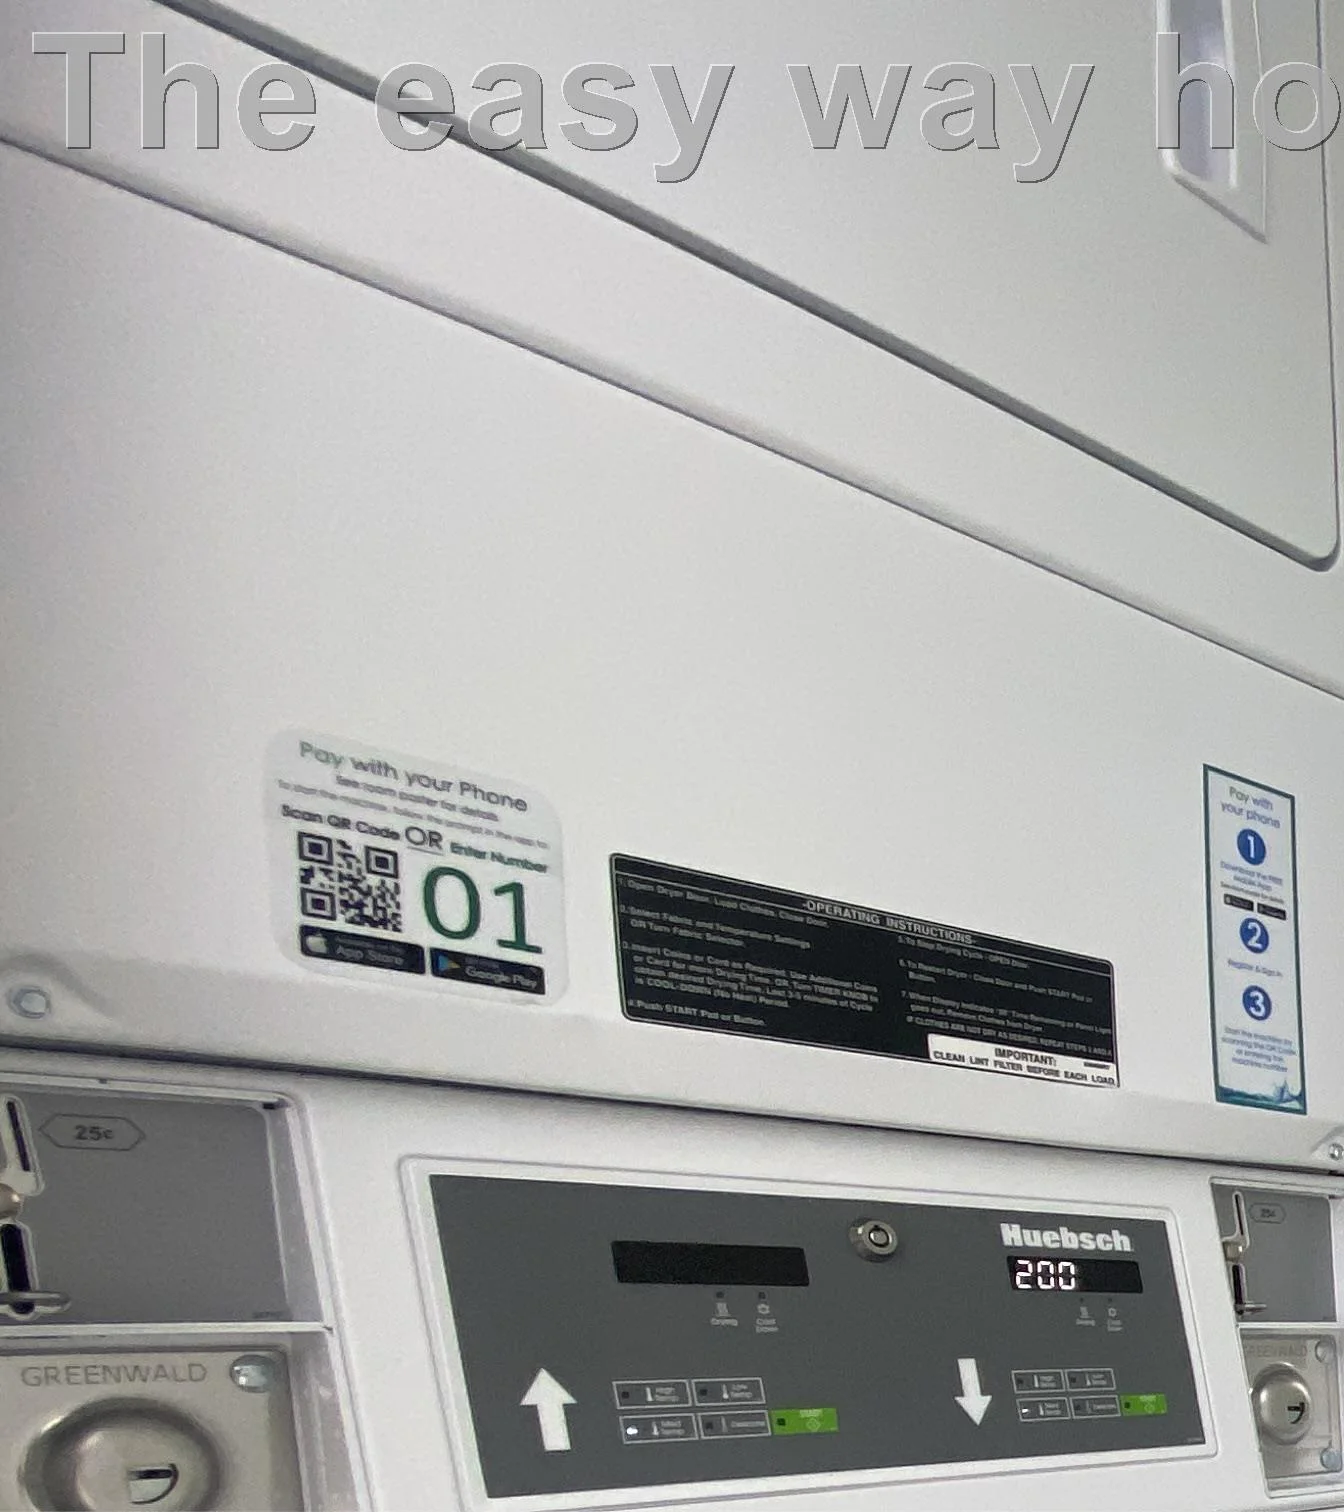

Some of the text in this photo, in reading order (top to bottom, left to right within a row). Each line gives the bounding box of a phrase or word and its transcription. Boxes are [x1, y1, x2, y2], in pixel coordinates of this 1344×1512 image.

[300, 740, 528, 812] Pay with your Phone
[1229, 786, 1273, 810] Pay with
[1220, 801, 1280, 829] your phone
[282, 804, 548, 873] Scan QR Code OR Enter Number
[422, 866, 543, 953] 01
[1247, 922, 1263, 949] 2
[335, 946, 404, 966] App Store
[465, 966, 537, 989] Google Play
[665, 1003, 697, 1016] START
[1250, 990, 1265, 1017] 3
[934, 1051, 965, 1063] CLEAN
[969, 1055, 989, 1066] LINT
[993, 1060, 1023, 1071] FILTER
[1026, 1065, 1060, 1078] BEFORE
[1064, 1070, 1088, 1081] EACH
[1000, 1223, 1132, 1252] Huebsch
[1015, 1260, 1076, 1290] 200
[20, 1363, 208, 1387] GREENWALD
